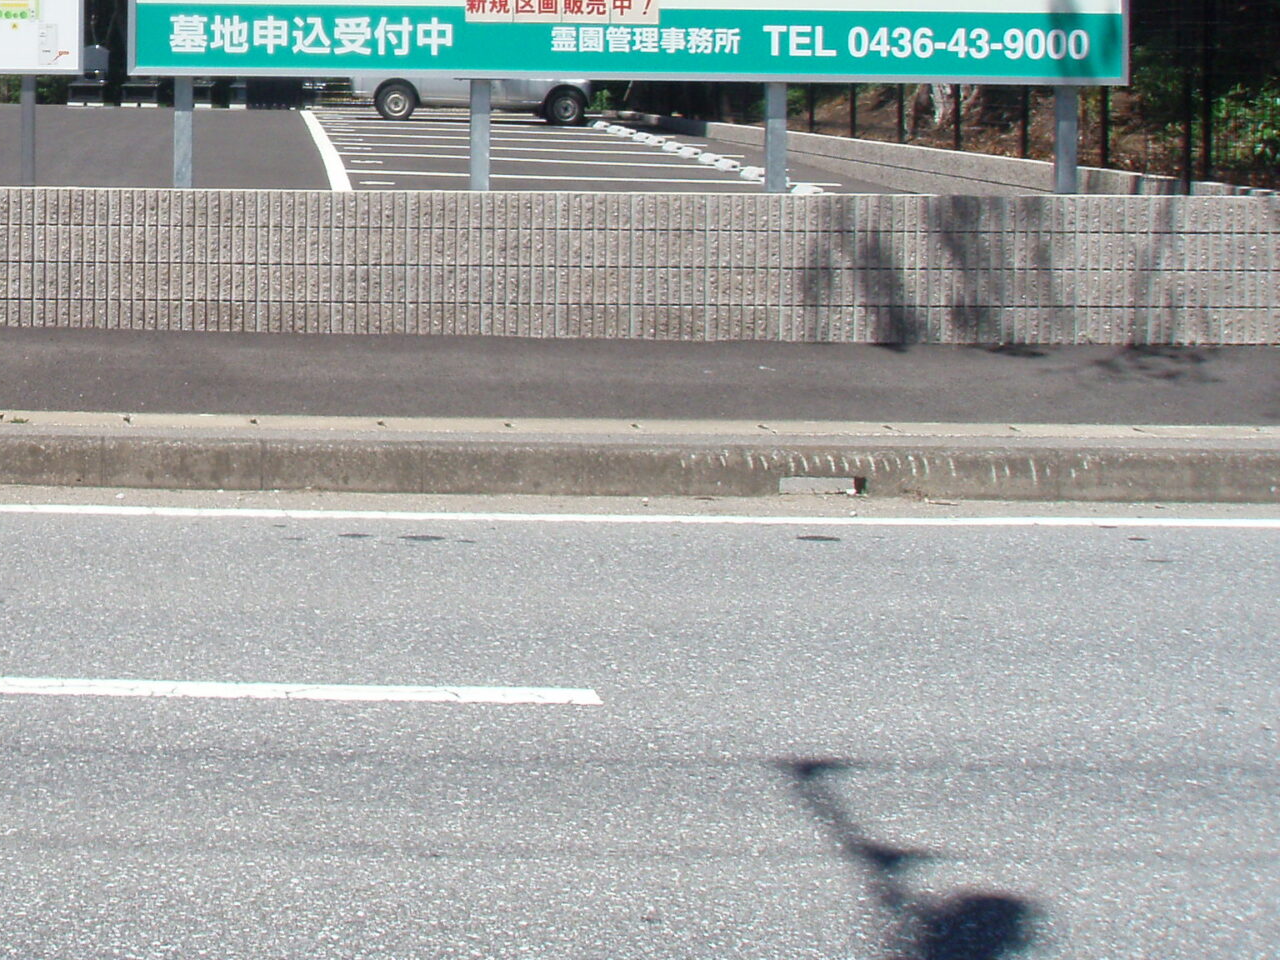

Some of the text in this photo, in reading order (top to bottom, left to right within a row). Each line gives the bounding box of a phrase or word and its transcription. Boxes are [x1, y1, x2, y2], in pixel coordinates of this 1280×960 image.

[169, 14, 453, 56] 墓地申込受付中
[550, 25, 741, 55] 霊園管理事務所
[762, 24, 1090, 60] TEL 0436-43-9000
